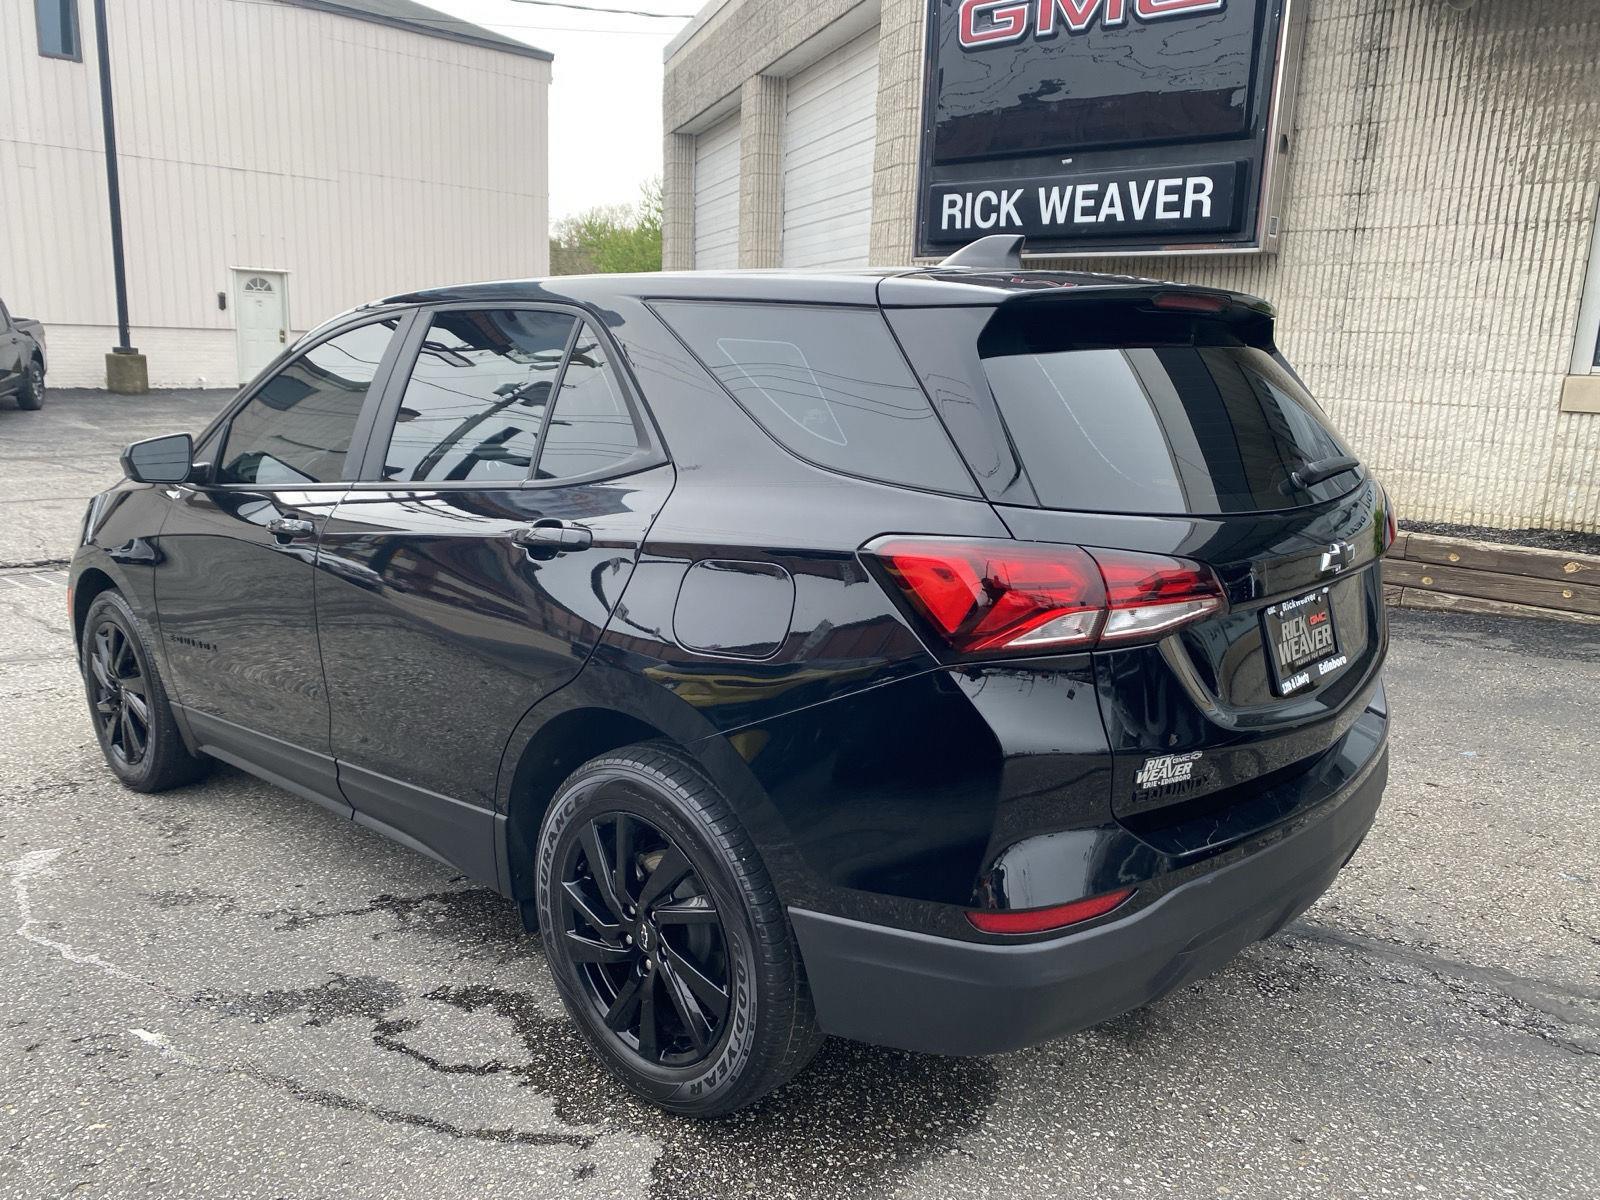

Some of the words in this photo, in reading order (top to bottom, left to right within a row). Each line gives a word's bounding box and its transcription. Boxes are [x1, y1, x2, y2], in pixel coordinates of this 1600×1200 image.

[941, 188, 1025, 230] RICK
[1038, 176, 1215, 225] WEAVER
[1281, 614, 1308, 642] RICK
[1309, 611, 1327, 626] GMC
[1278, 623, 1332, 666] WEAVER
[1136, 761, 1193, 784] WEAVER
[1144, 754, 1175, 771] RICK
